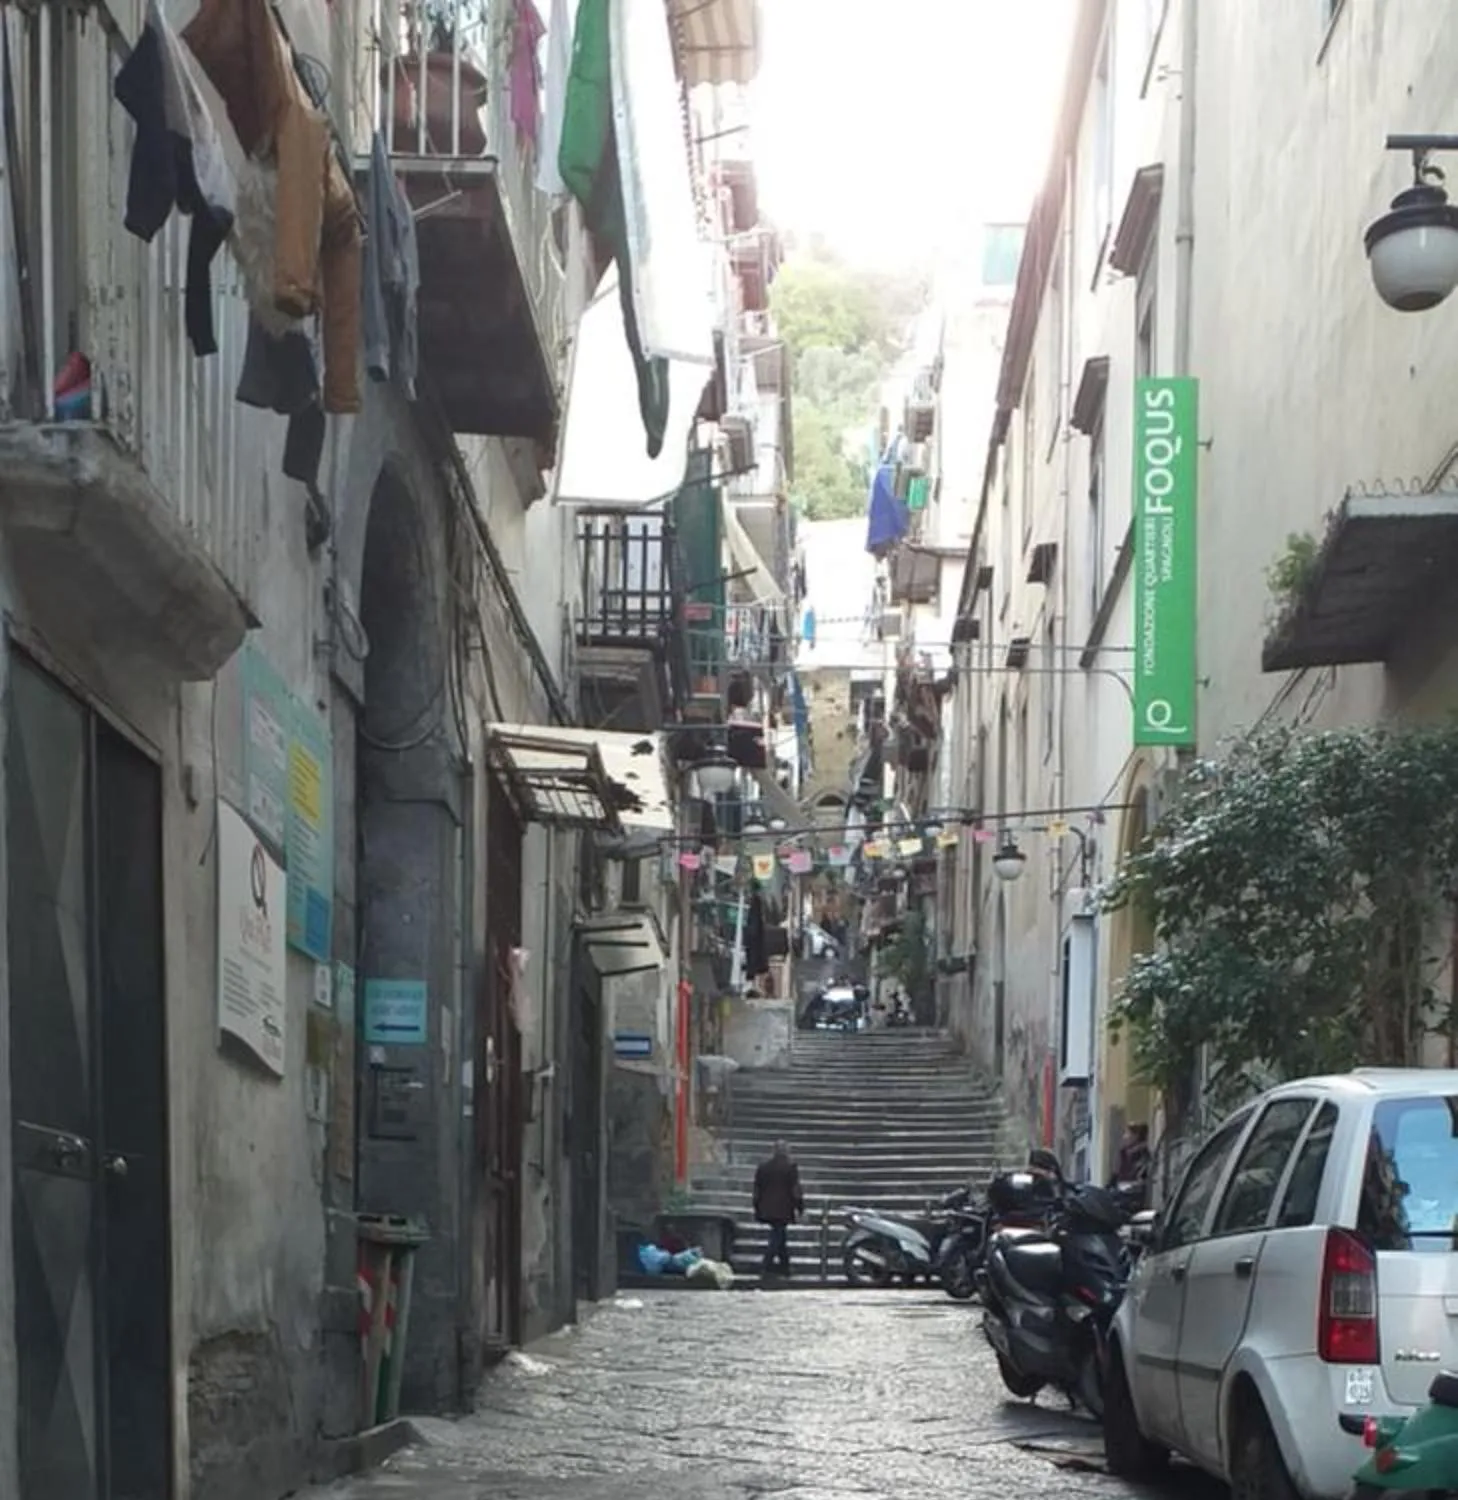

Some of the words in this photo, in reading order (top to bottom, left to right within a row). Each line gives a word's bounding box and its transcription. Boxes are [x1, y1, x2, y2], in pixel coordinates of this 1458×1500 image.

[1144, 387, 1182, 515] FOQUS
[1143, 518, 1158, 586] QUARTIERI
[1160, 518, 1174, 582] SPAGNOLI
[1143, 589, 1156, 676] FONDAZIONE
